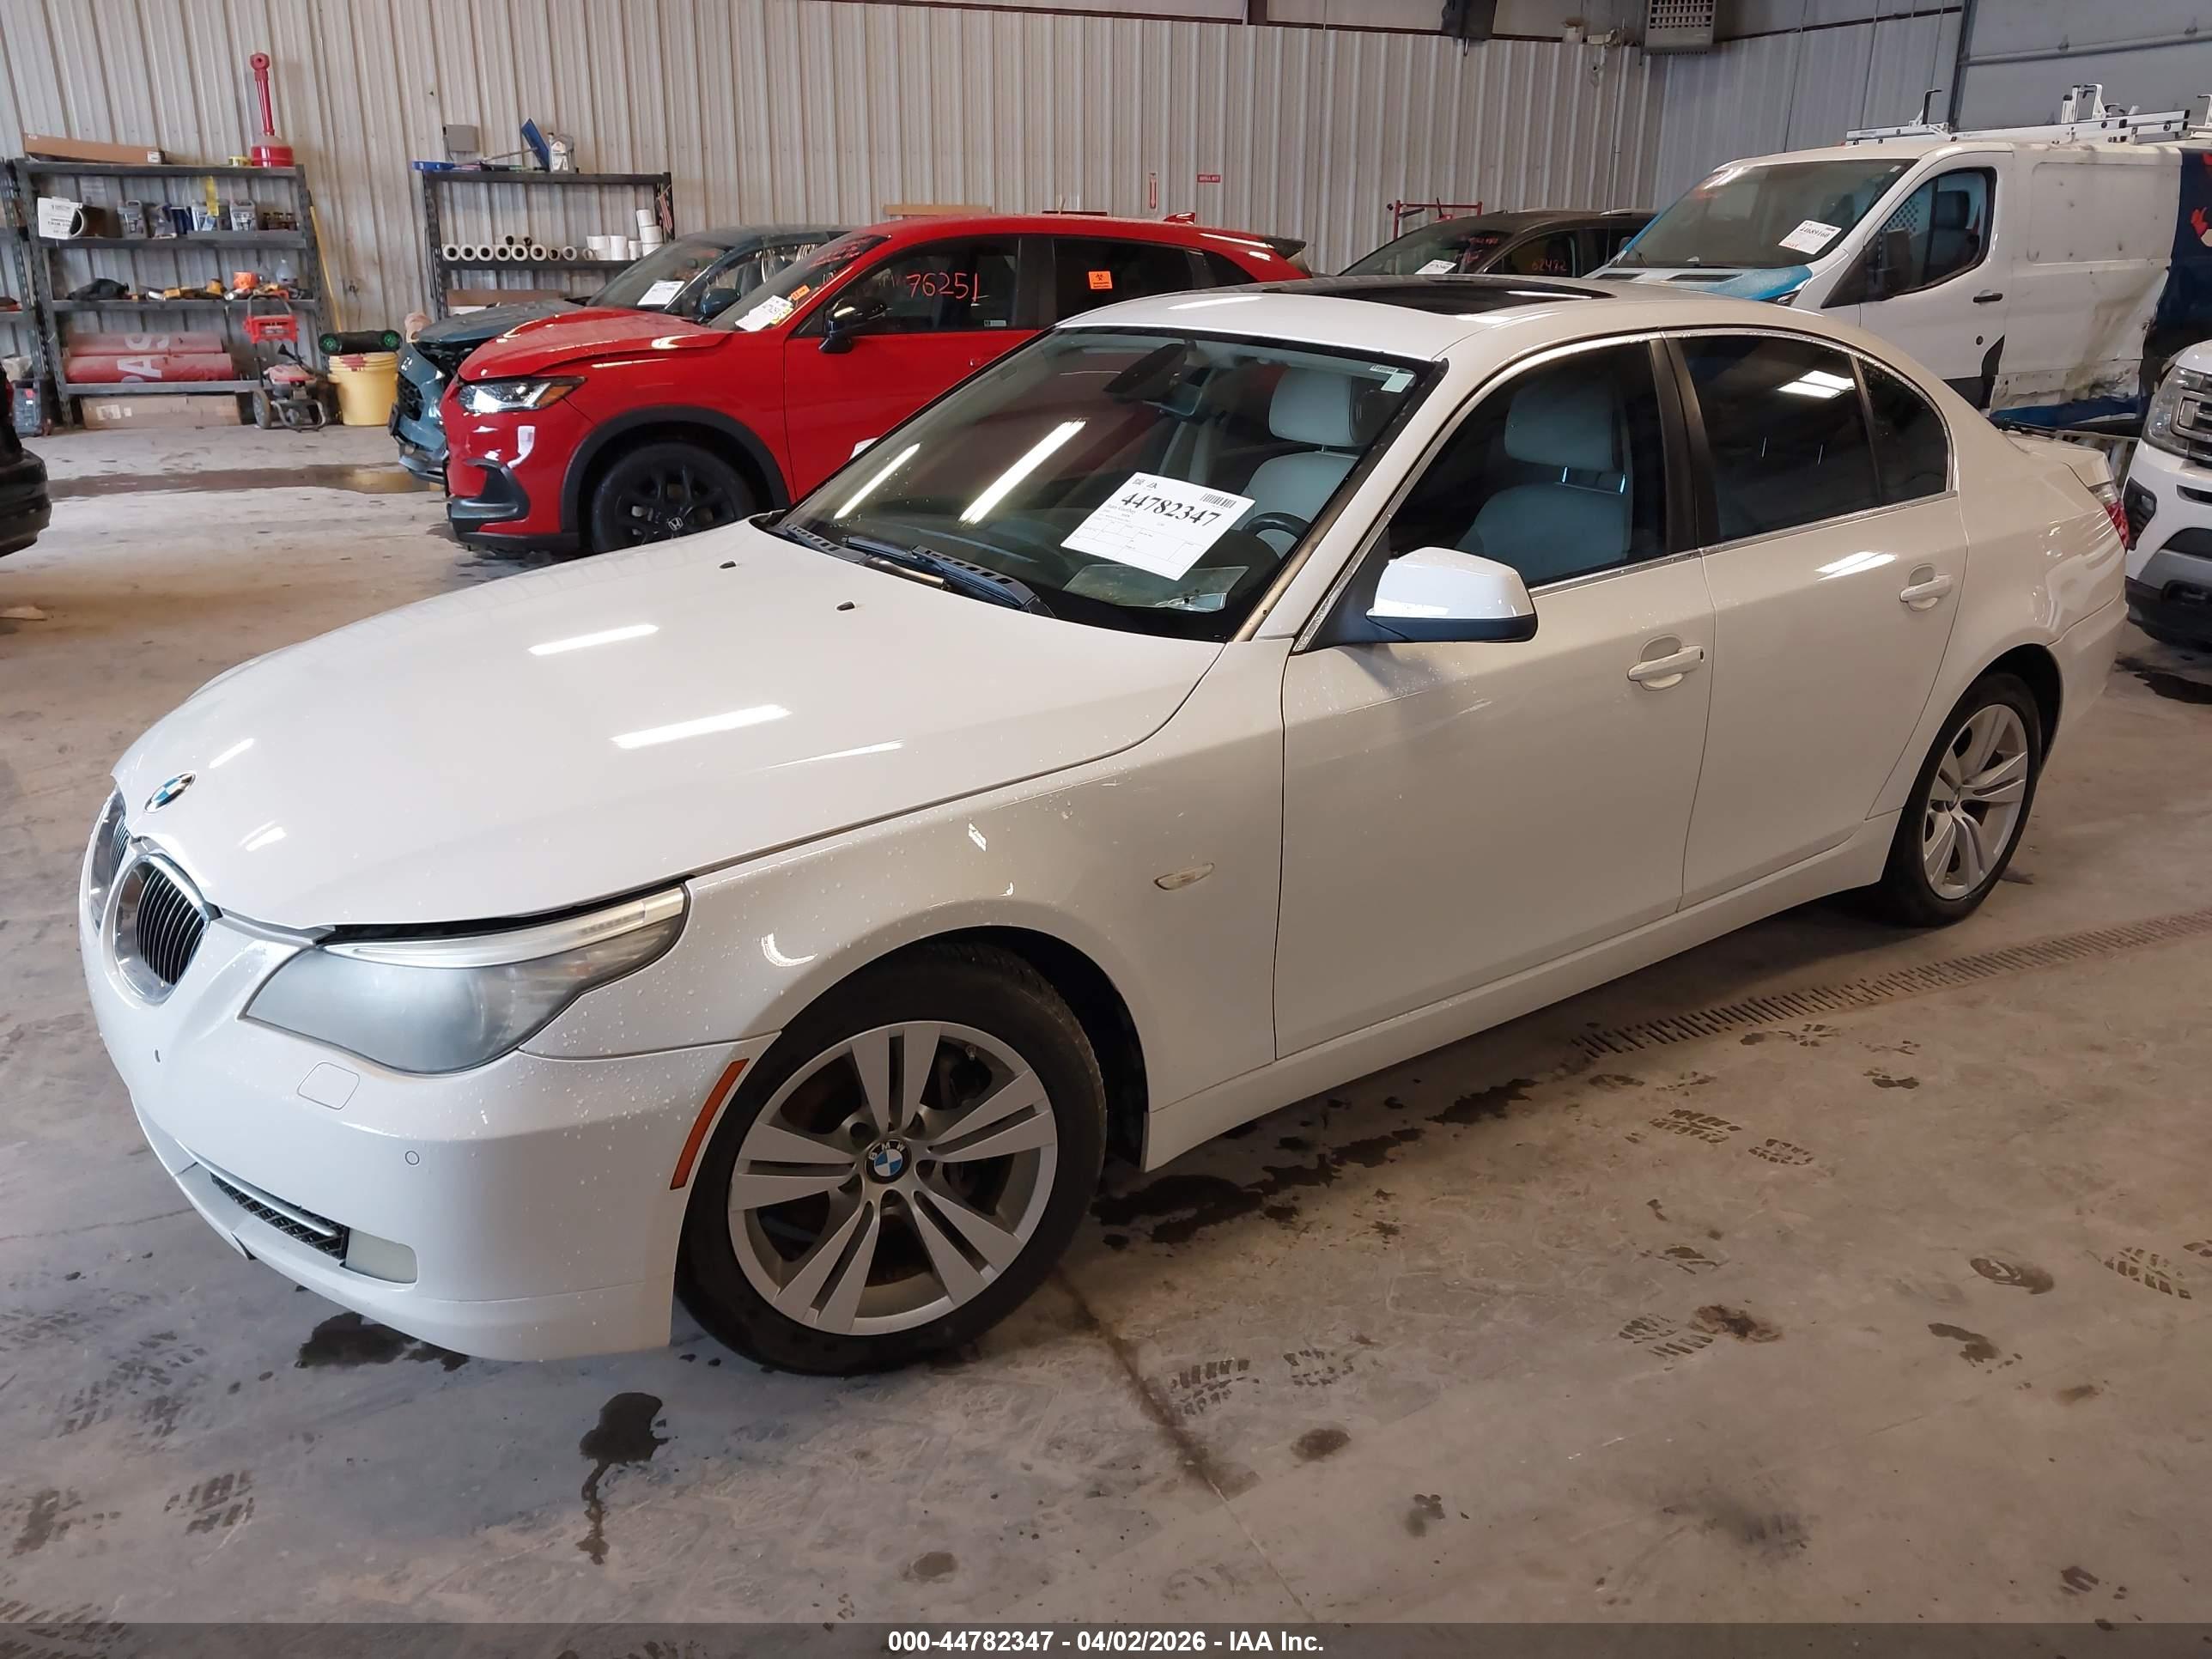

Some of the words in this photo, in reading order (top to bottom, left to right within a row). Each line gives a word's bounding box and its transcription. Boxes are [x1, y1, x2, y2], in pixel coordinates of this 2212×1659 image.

[907, 271, 979, 302] 76251
[1121, 492, 1223, 526] 44782347
[868, 1141, 906, 1160] BMW
